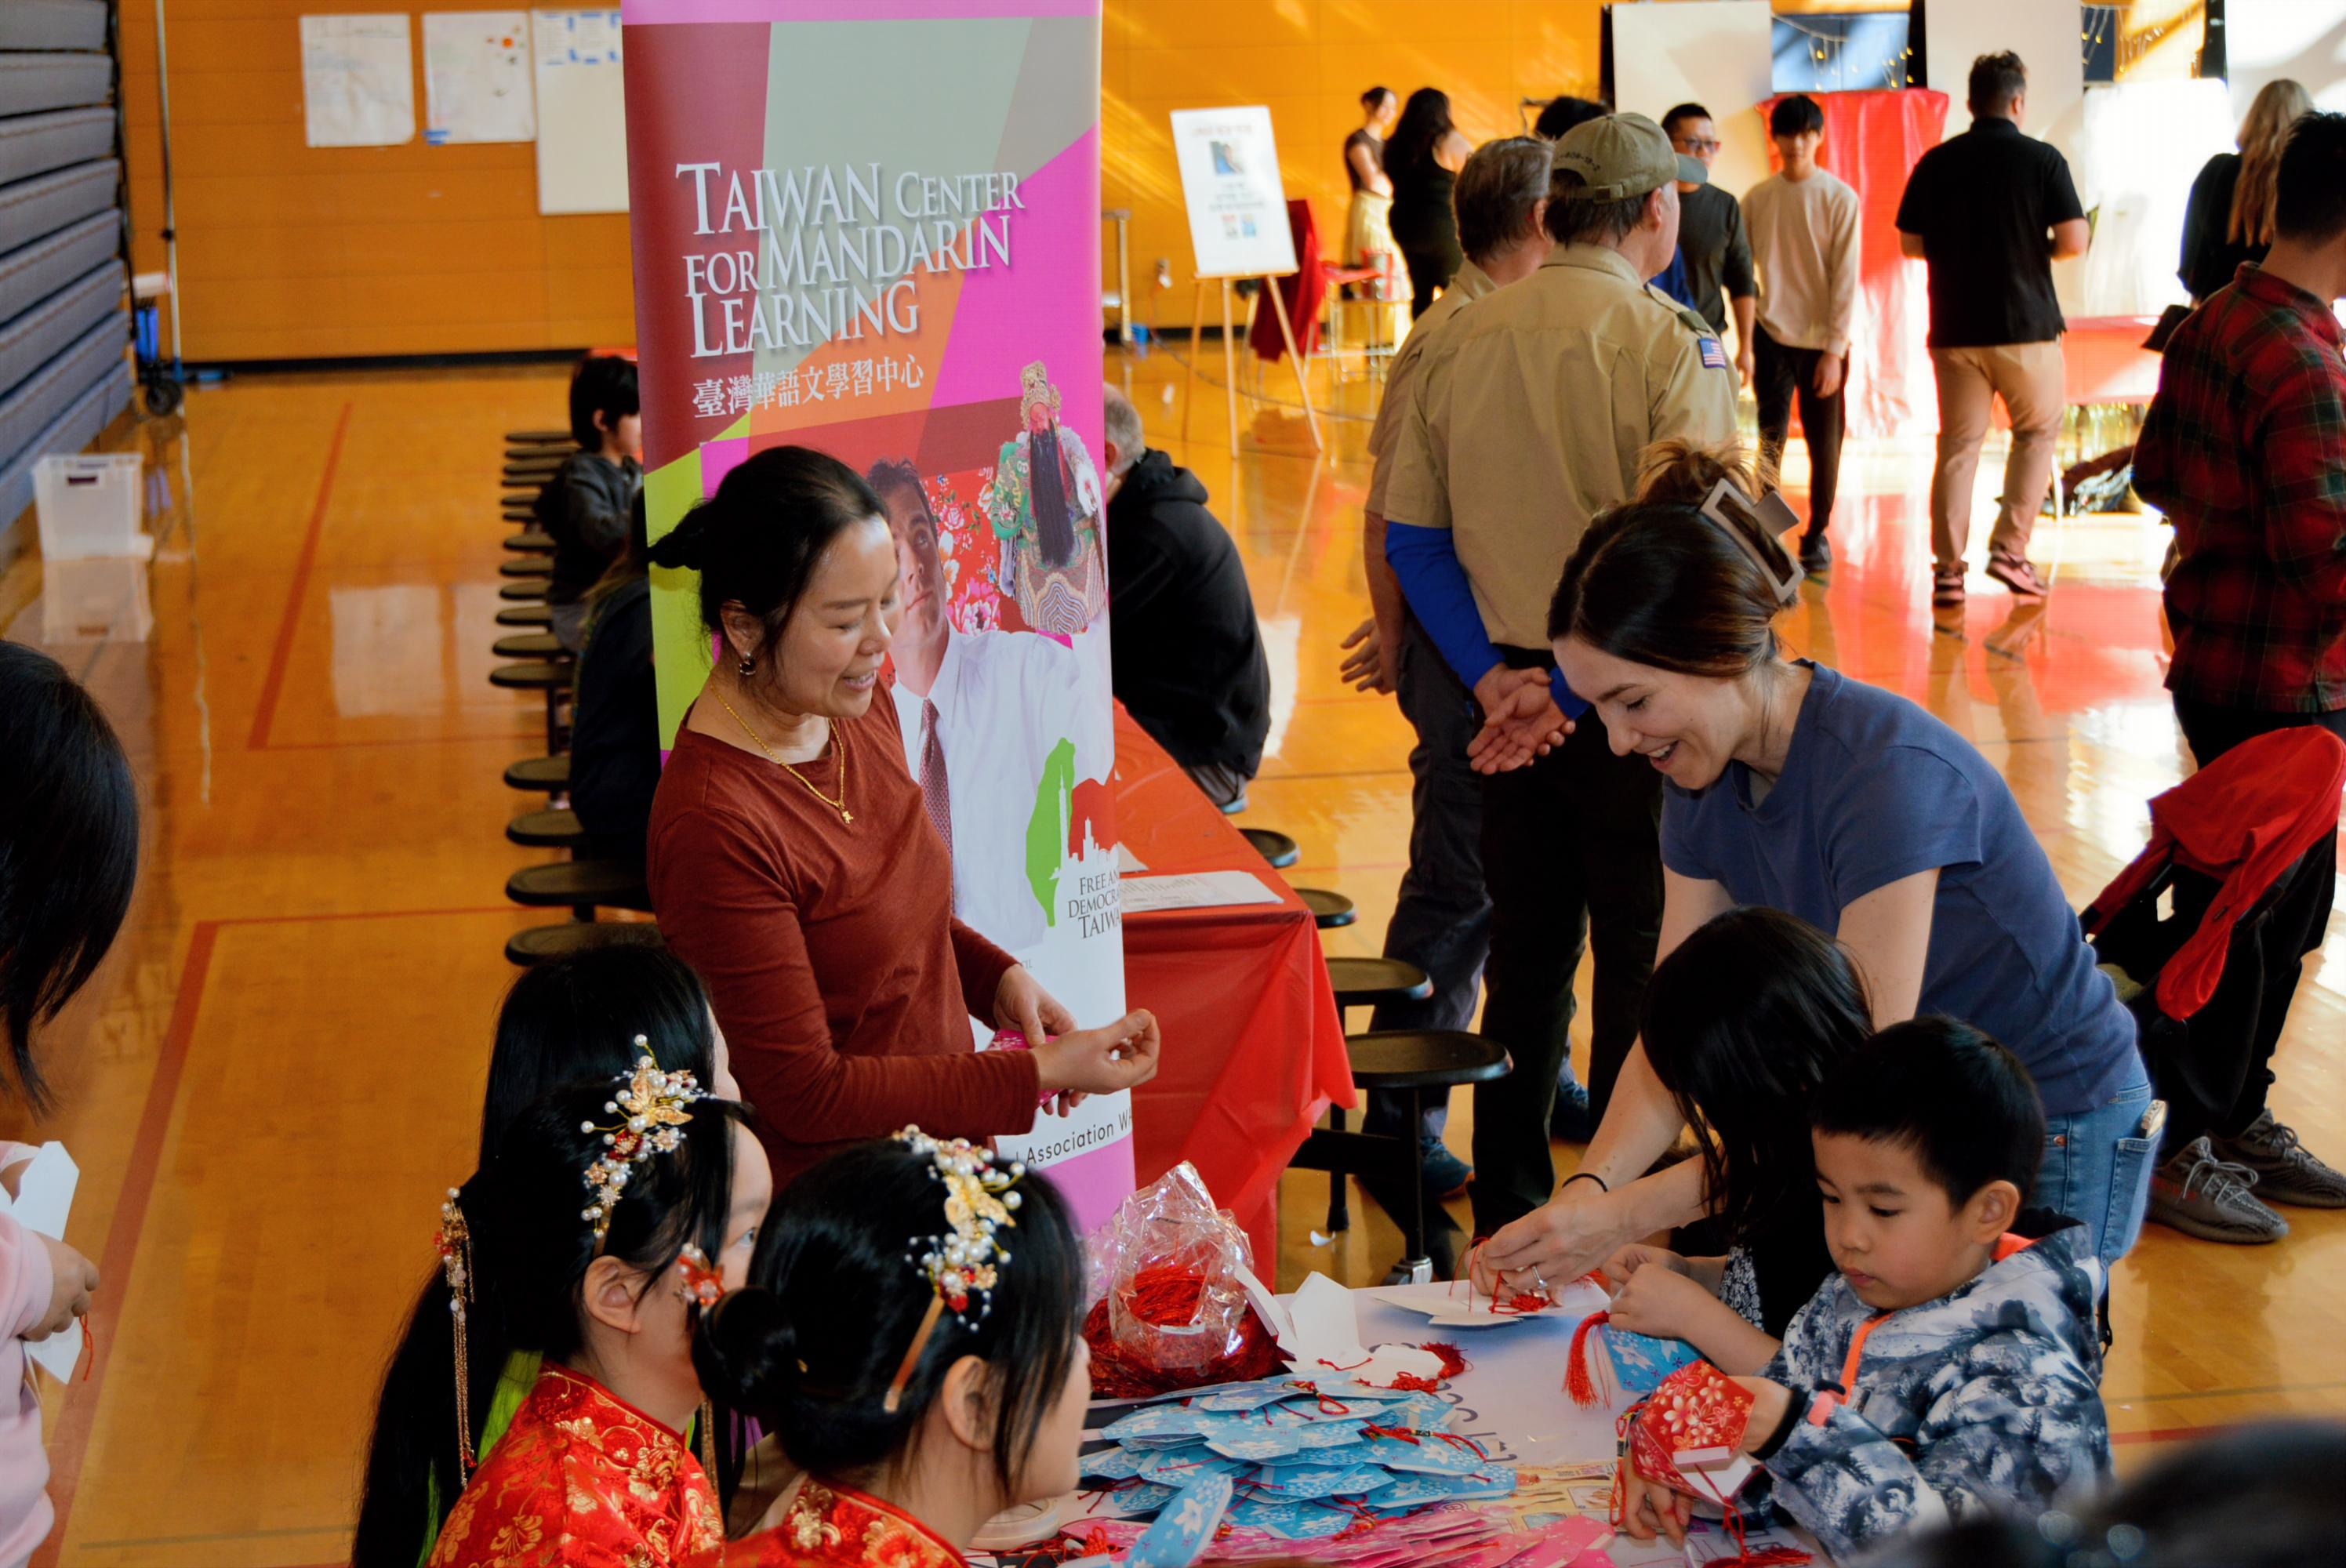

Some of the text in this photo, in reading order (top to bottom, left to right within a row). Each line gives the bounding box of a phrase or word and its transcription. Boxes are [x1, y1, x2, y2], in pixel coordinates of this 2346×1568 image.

[675, 162, 1026, 235] TAIWAN CENTER
[682, 214, 1011, 298] FOR MANDARIN
[688, 280, 919, 358] LEARNING
[692, 354, 924, 419] 臺灣華語文學習中心
[1079, 872, 1106, 895] FREE
[1025, 1123, 1114, 1167] Association
